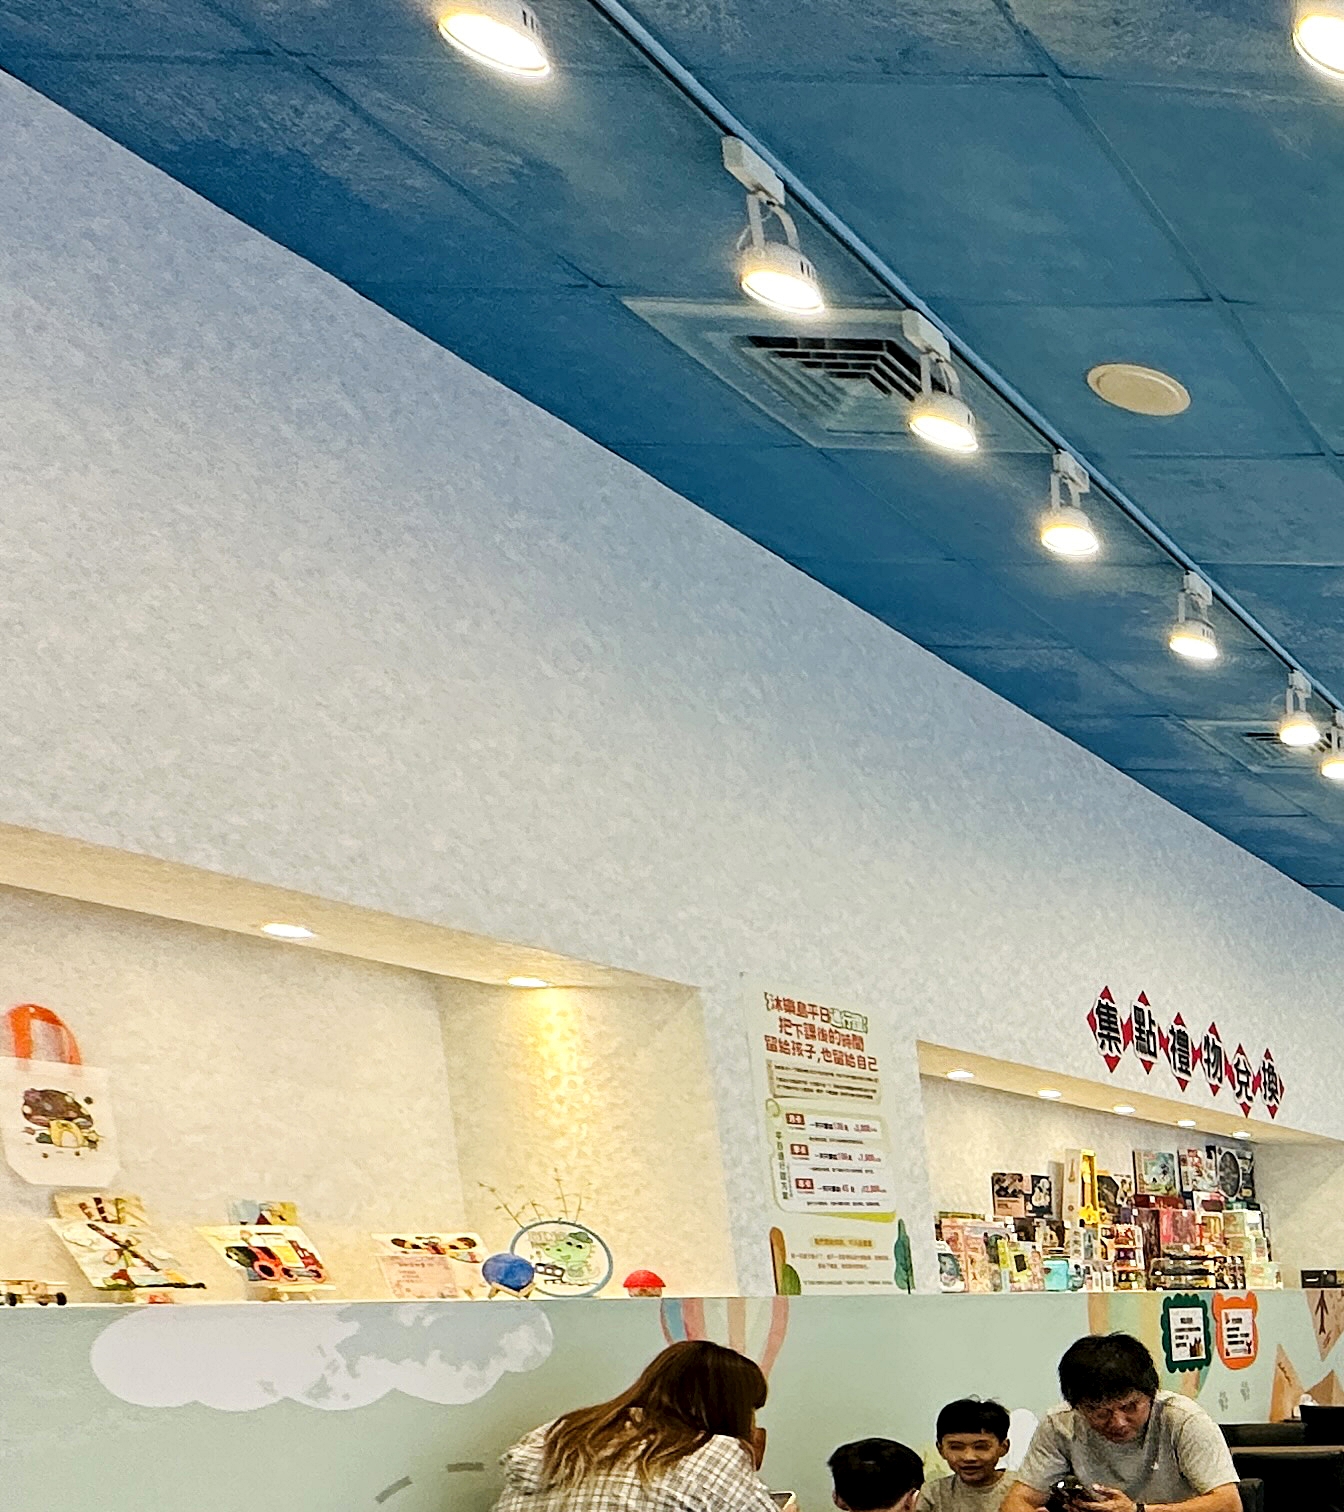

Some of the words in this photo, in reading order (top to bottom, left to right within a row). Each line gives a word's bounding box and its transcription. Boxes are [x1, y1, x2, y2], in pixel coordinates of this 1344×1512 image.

[1095, 999, 1280, 1105] 集點禮物兌換
